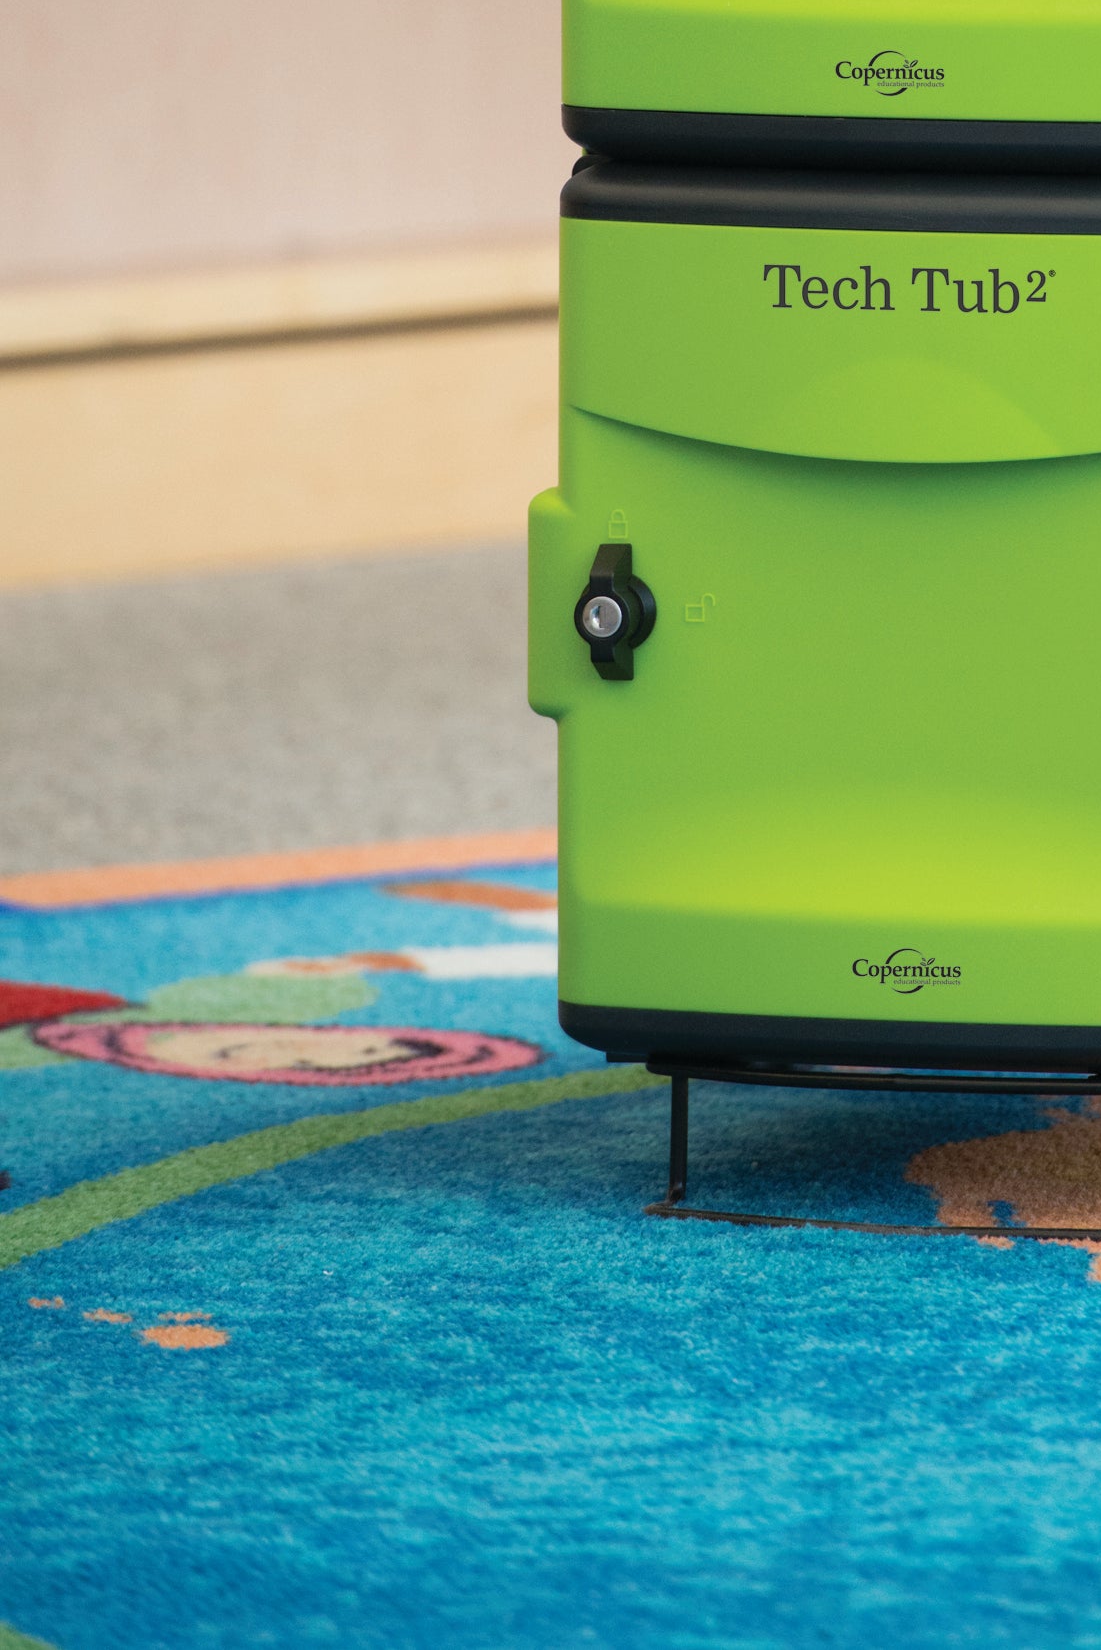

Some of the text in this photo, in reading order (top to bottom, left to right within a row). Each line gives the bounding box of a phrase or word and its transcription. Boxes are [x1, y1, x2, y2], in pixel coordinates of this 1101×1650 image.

[835, 60, 945, 86] Copernicus
[763, 264, 896, 311] Tech
[852, 958, 962, 984] Copernicus
